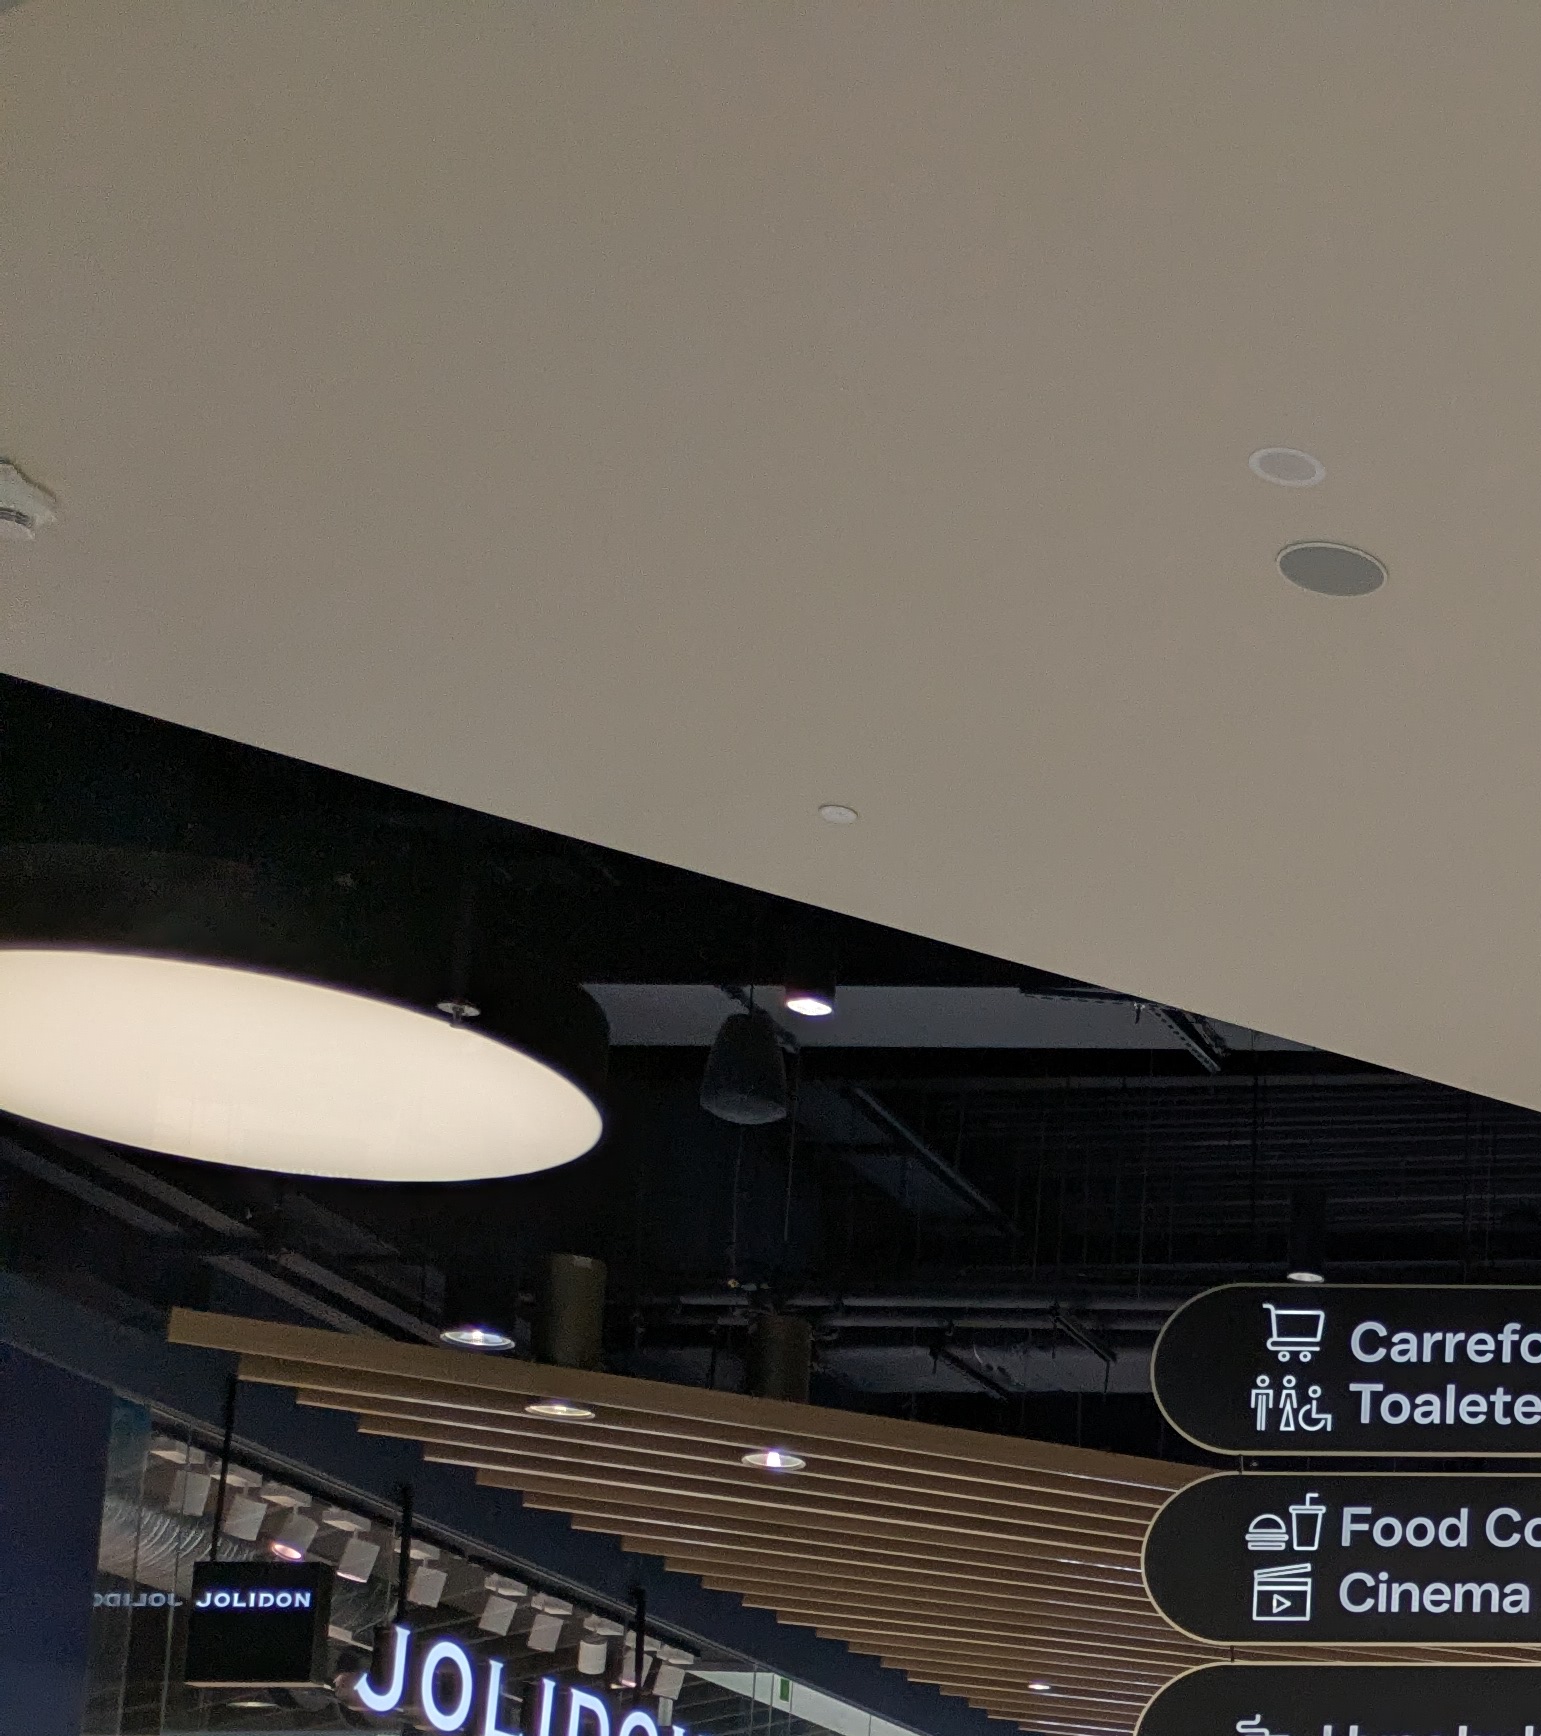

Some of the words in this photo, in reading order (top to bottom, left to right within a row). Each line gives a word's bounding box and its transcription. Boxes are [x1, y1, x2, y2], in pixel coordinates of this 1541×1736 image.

[1341, 1506, 1468, 1548] Food
[196, 1592, 311, 1608] JOLIDON
[1339, 1571, 1530, 1614] Cinema
